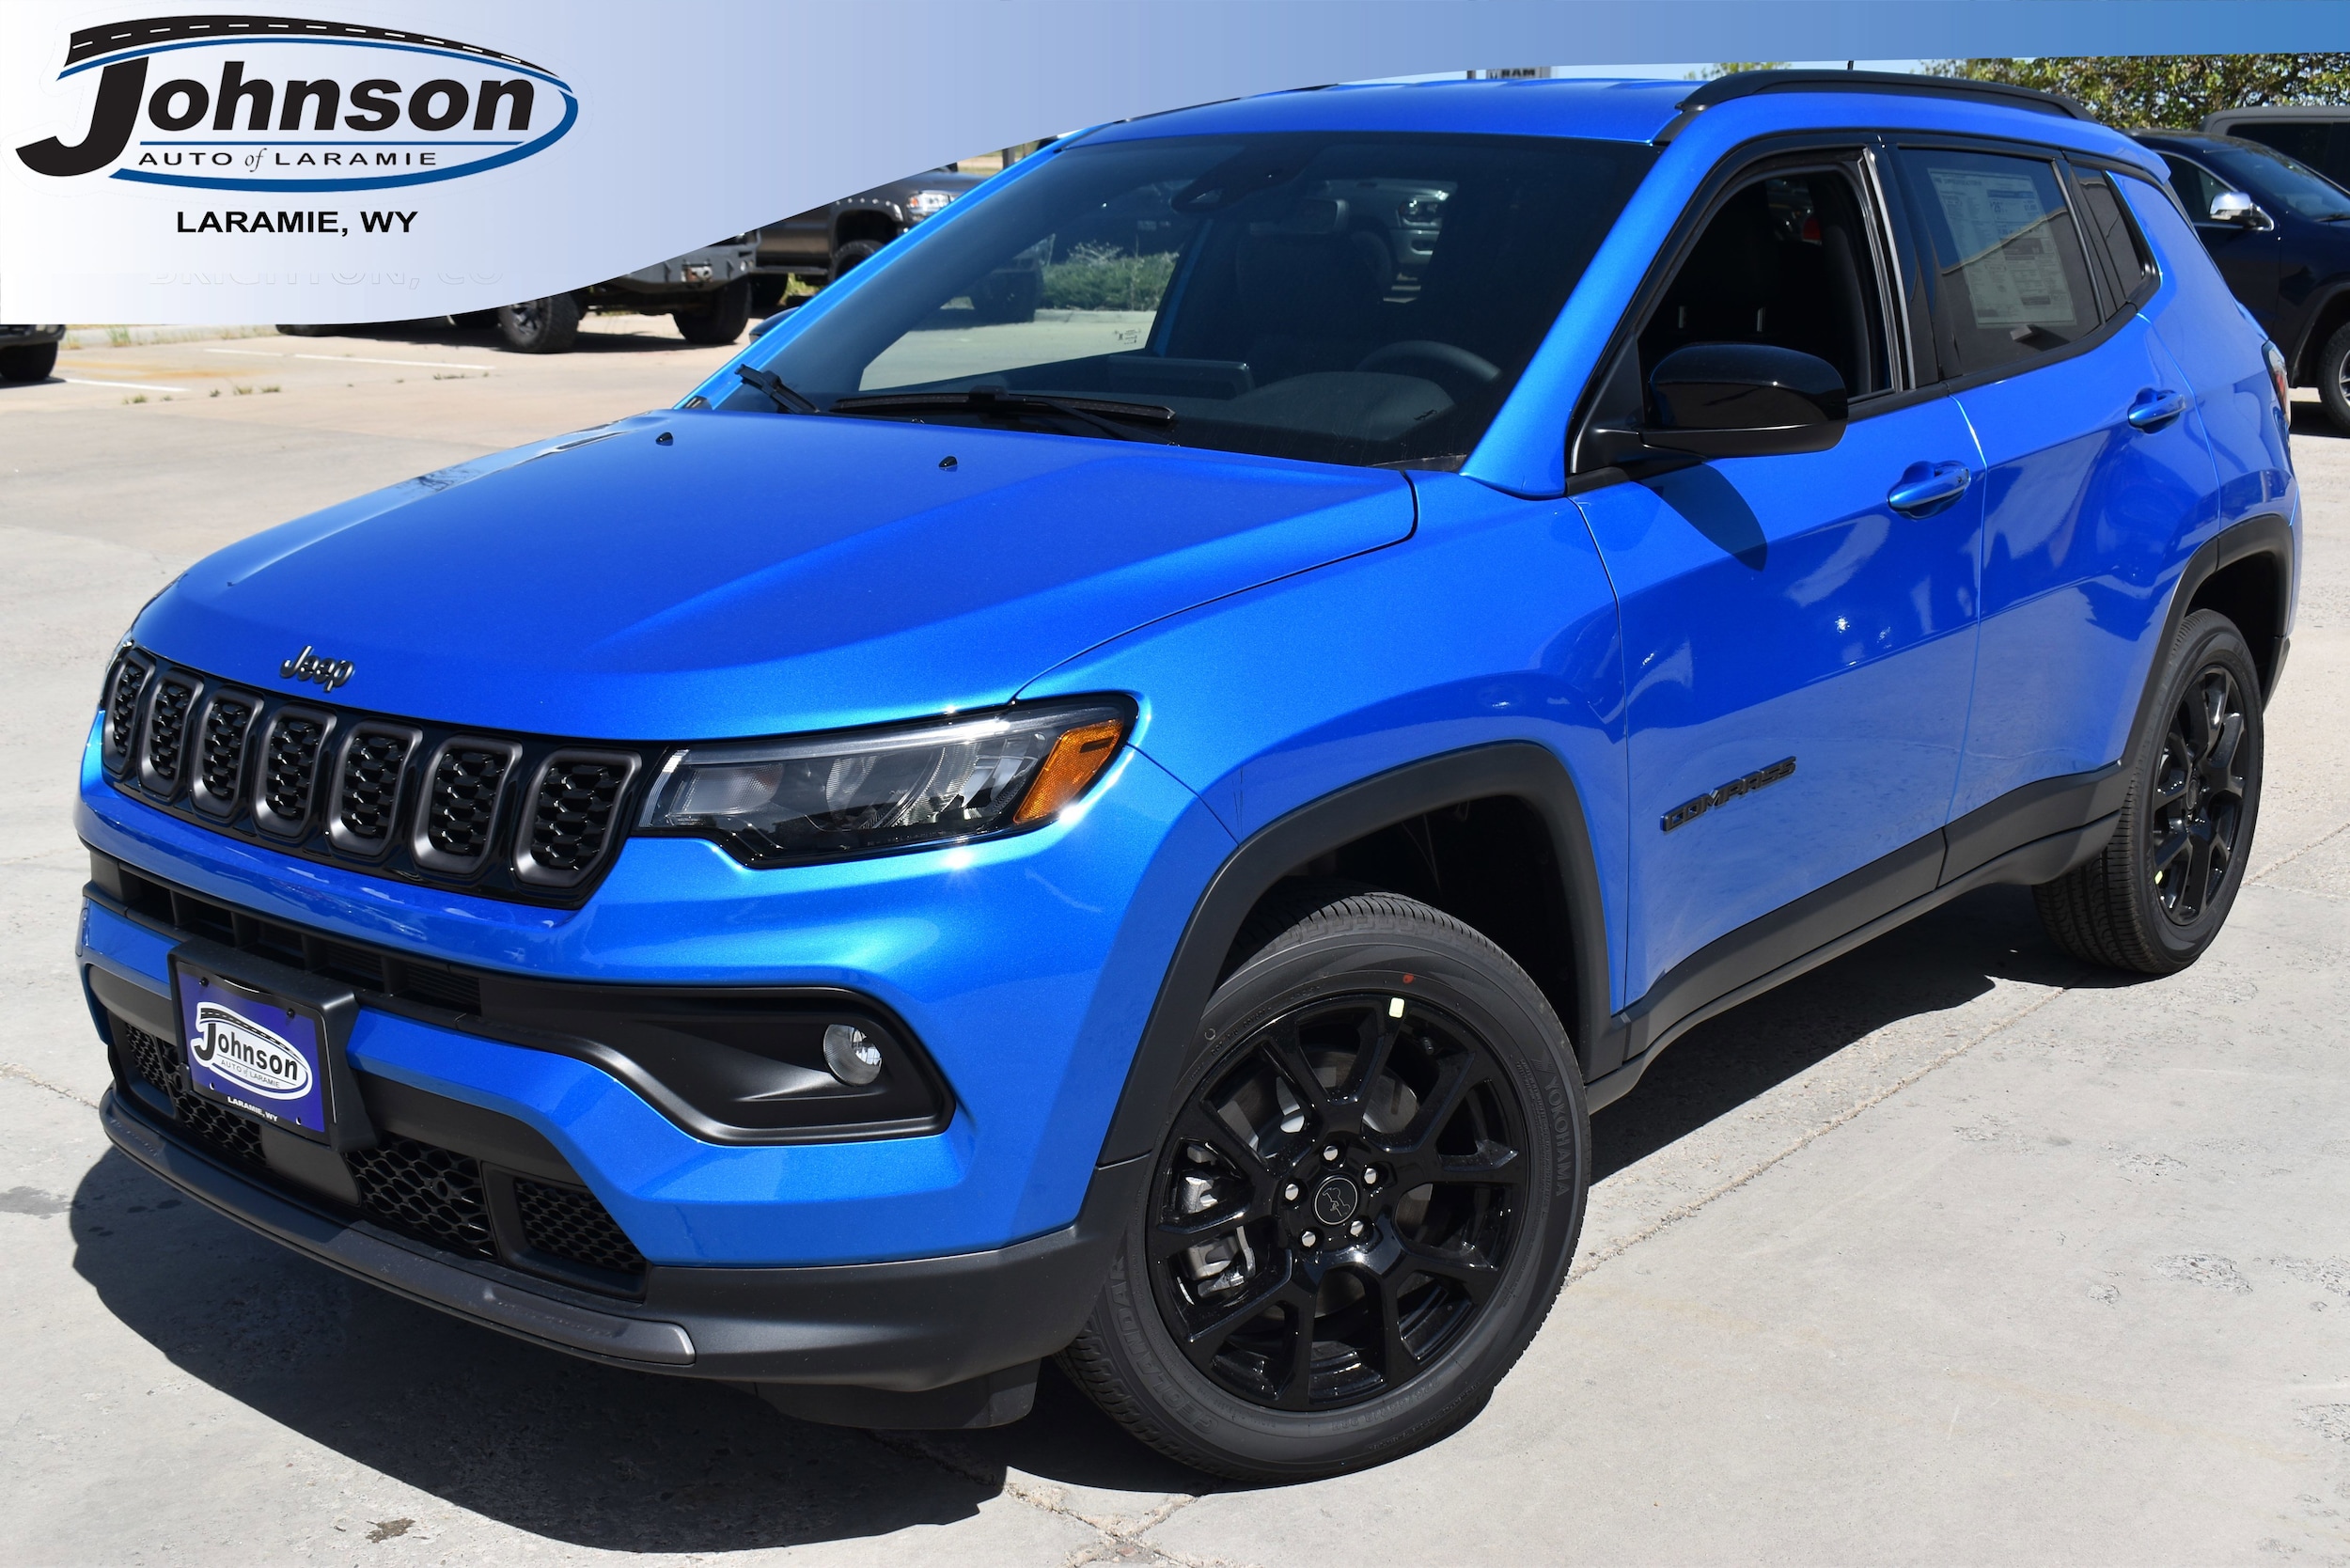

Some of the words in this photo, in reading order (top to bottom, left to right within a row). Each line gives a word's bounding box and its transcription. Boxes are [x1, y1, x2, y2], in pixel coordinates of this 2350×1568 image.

[1501, 69, 1536, 78] RAM
[280, 645, 354, 692] Jeep
[1660, 756, 1797, 832] COMPASS
[194, 1023, 298, 1081] Johnson
[221, 1059, 243, 1074] AUTO
[249, 1072, 280, 1088] LARAMIE
[265, 1112, 278, 1122] WY
[1543, 1076, 1575, 1198] YOKOHAMA
[1109, 1256, 1218, 1435] GEOLANDAR
